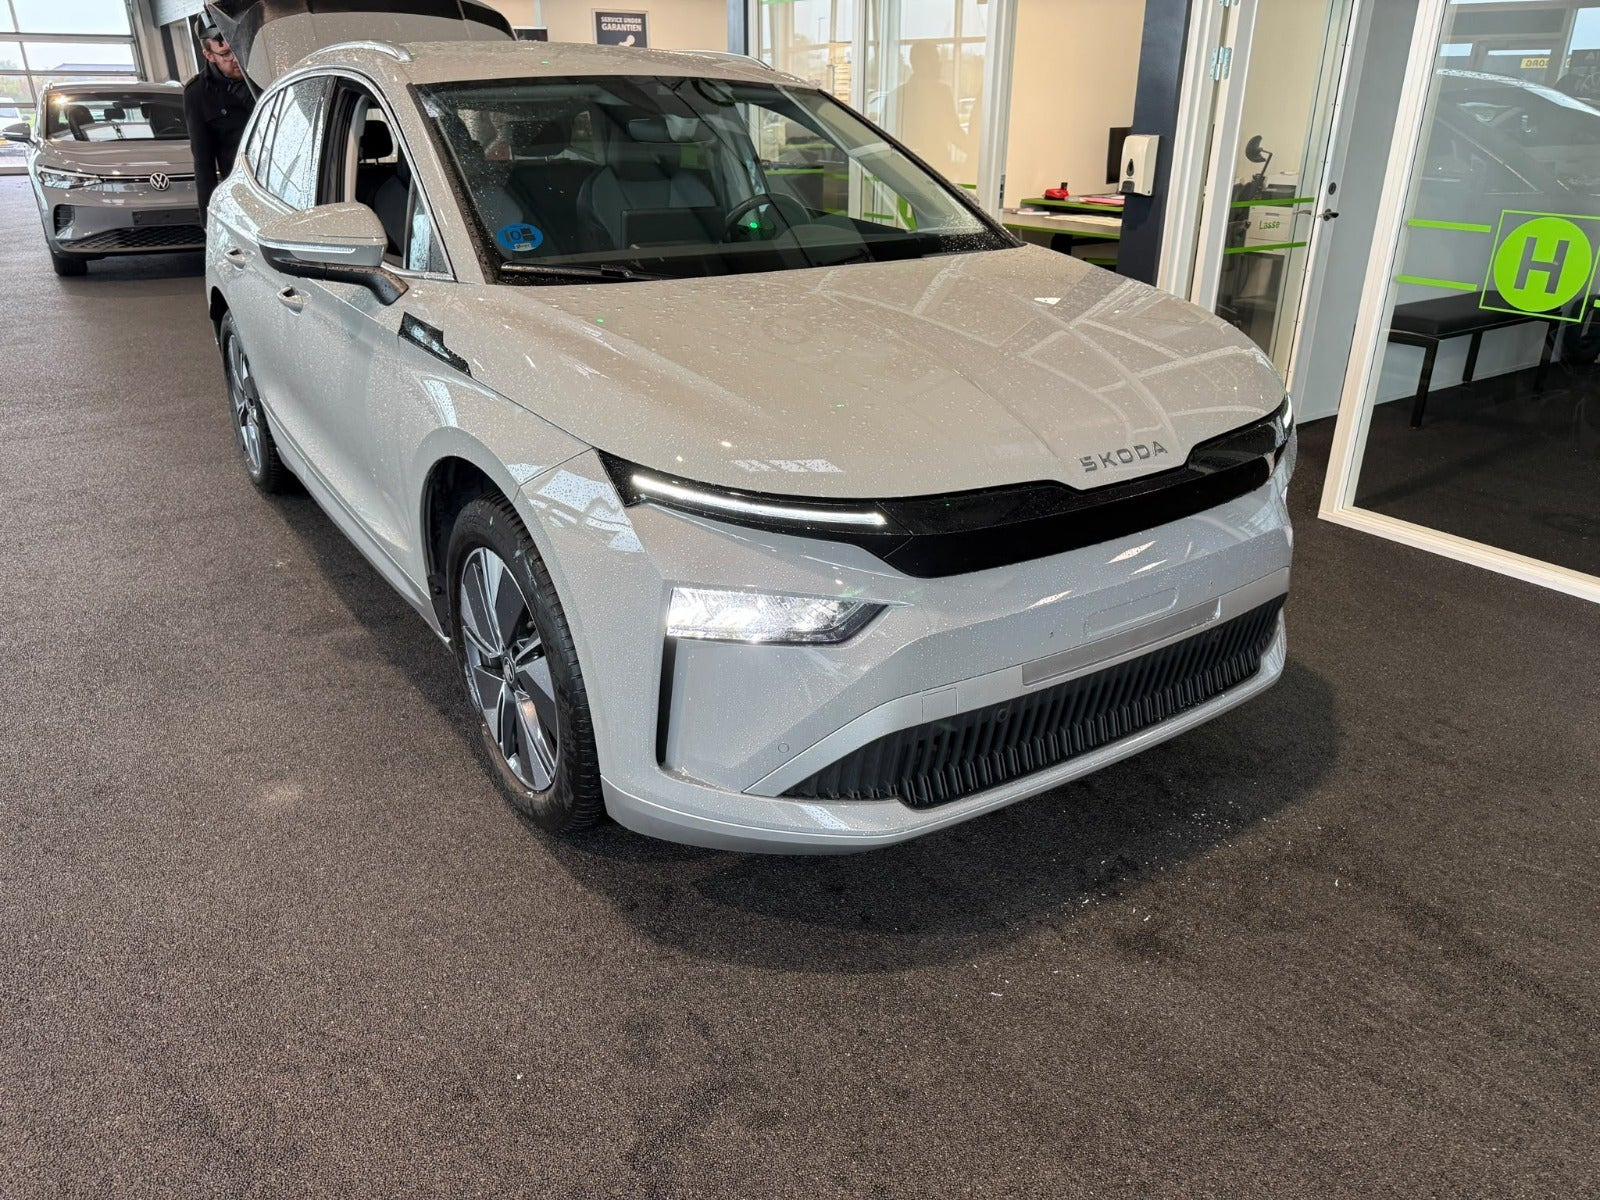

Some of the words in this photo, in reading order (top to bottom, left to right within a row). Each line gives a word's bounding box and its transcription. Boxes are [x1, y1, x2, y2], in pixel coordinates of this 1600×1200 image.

[601, 23, 642, 32] GARANTIEN
[151, 172, 169, 190] VW
[1259, 221, 1280, 230] Lasse
[1513, 236, 1571, 295] H
